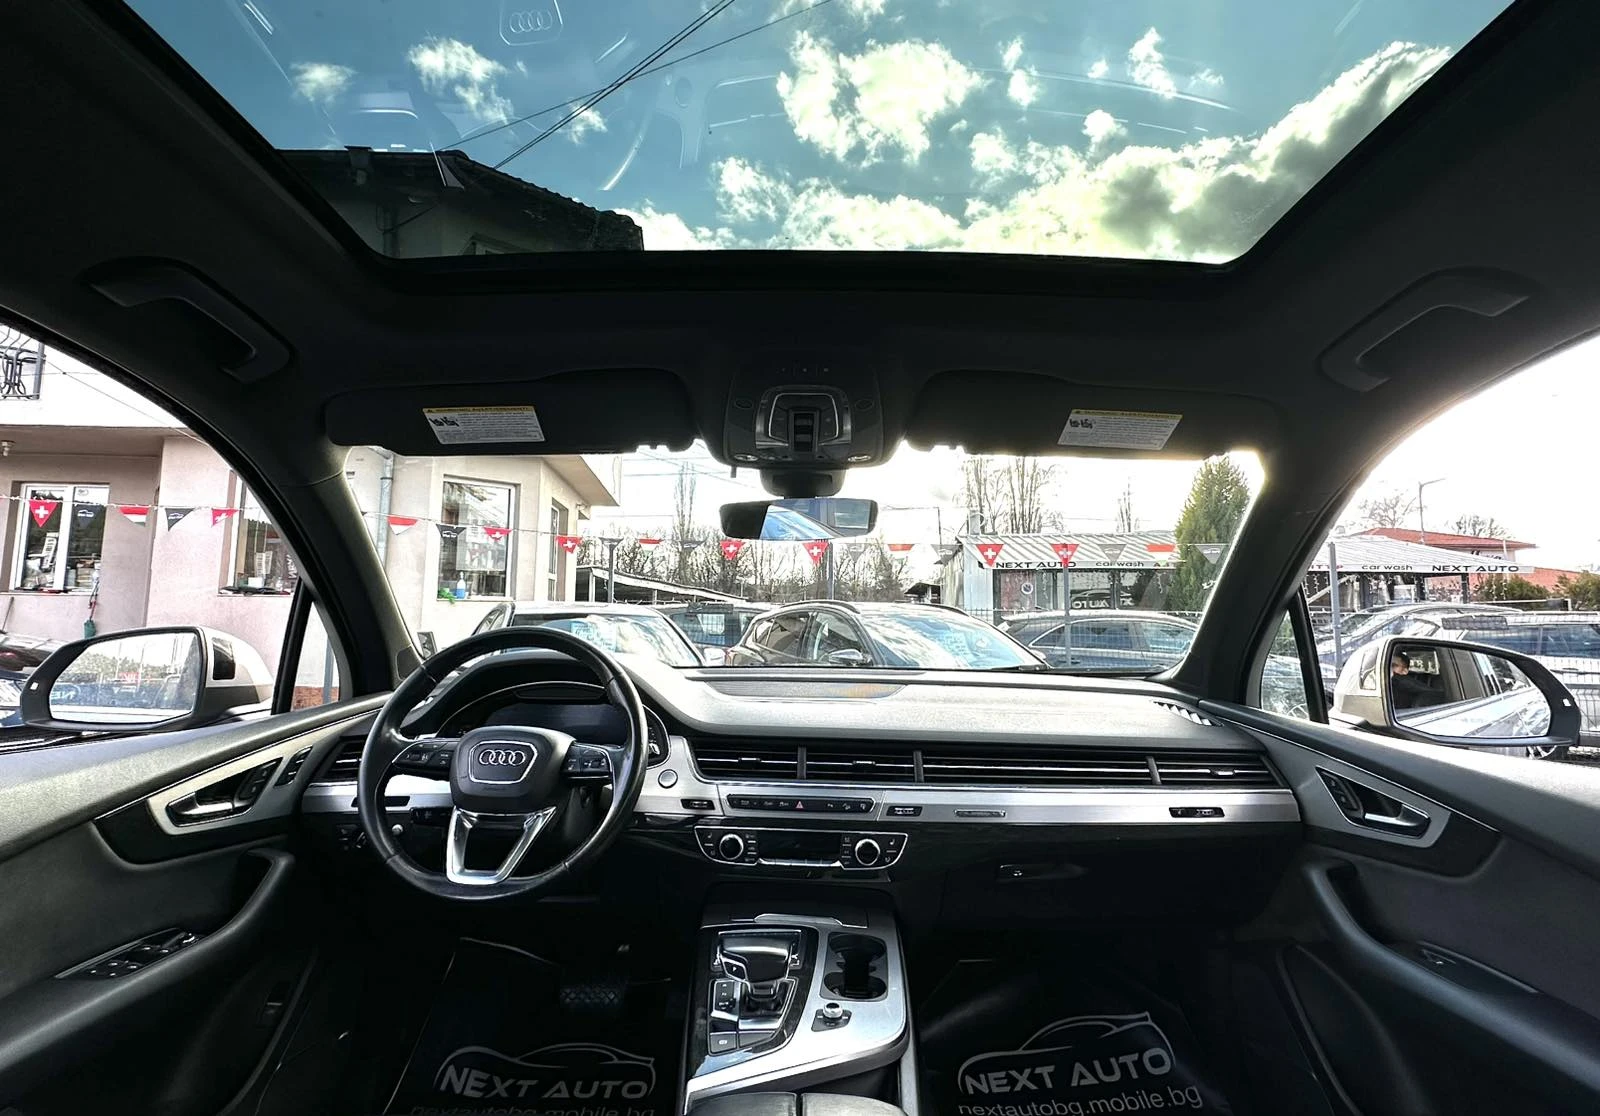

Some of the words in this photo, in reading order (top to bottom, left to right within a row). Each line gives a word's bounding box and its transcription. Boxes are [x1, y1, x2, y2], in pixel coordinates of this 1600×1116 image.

[995, 561, 1033, 569] NEXT
[1036, 561, 1077, 569] AUTO
[1116, 560, 1145, 568] wash
[1475, 565, 1520, 573] AUTO
[964, 1064, 1056, 1096] NEXT
[1070, 1047, 1173, 1088] AUTO
[439, 1064, 539, 1099] NEXT
[541, 1080, 649, 1099] AUTO
[958, 1085, 1204, 1116] nextautobg.mobile.bg
[409, 1105, 656, 1116] nextautobgmobilebg
